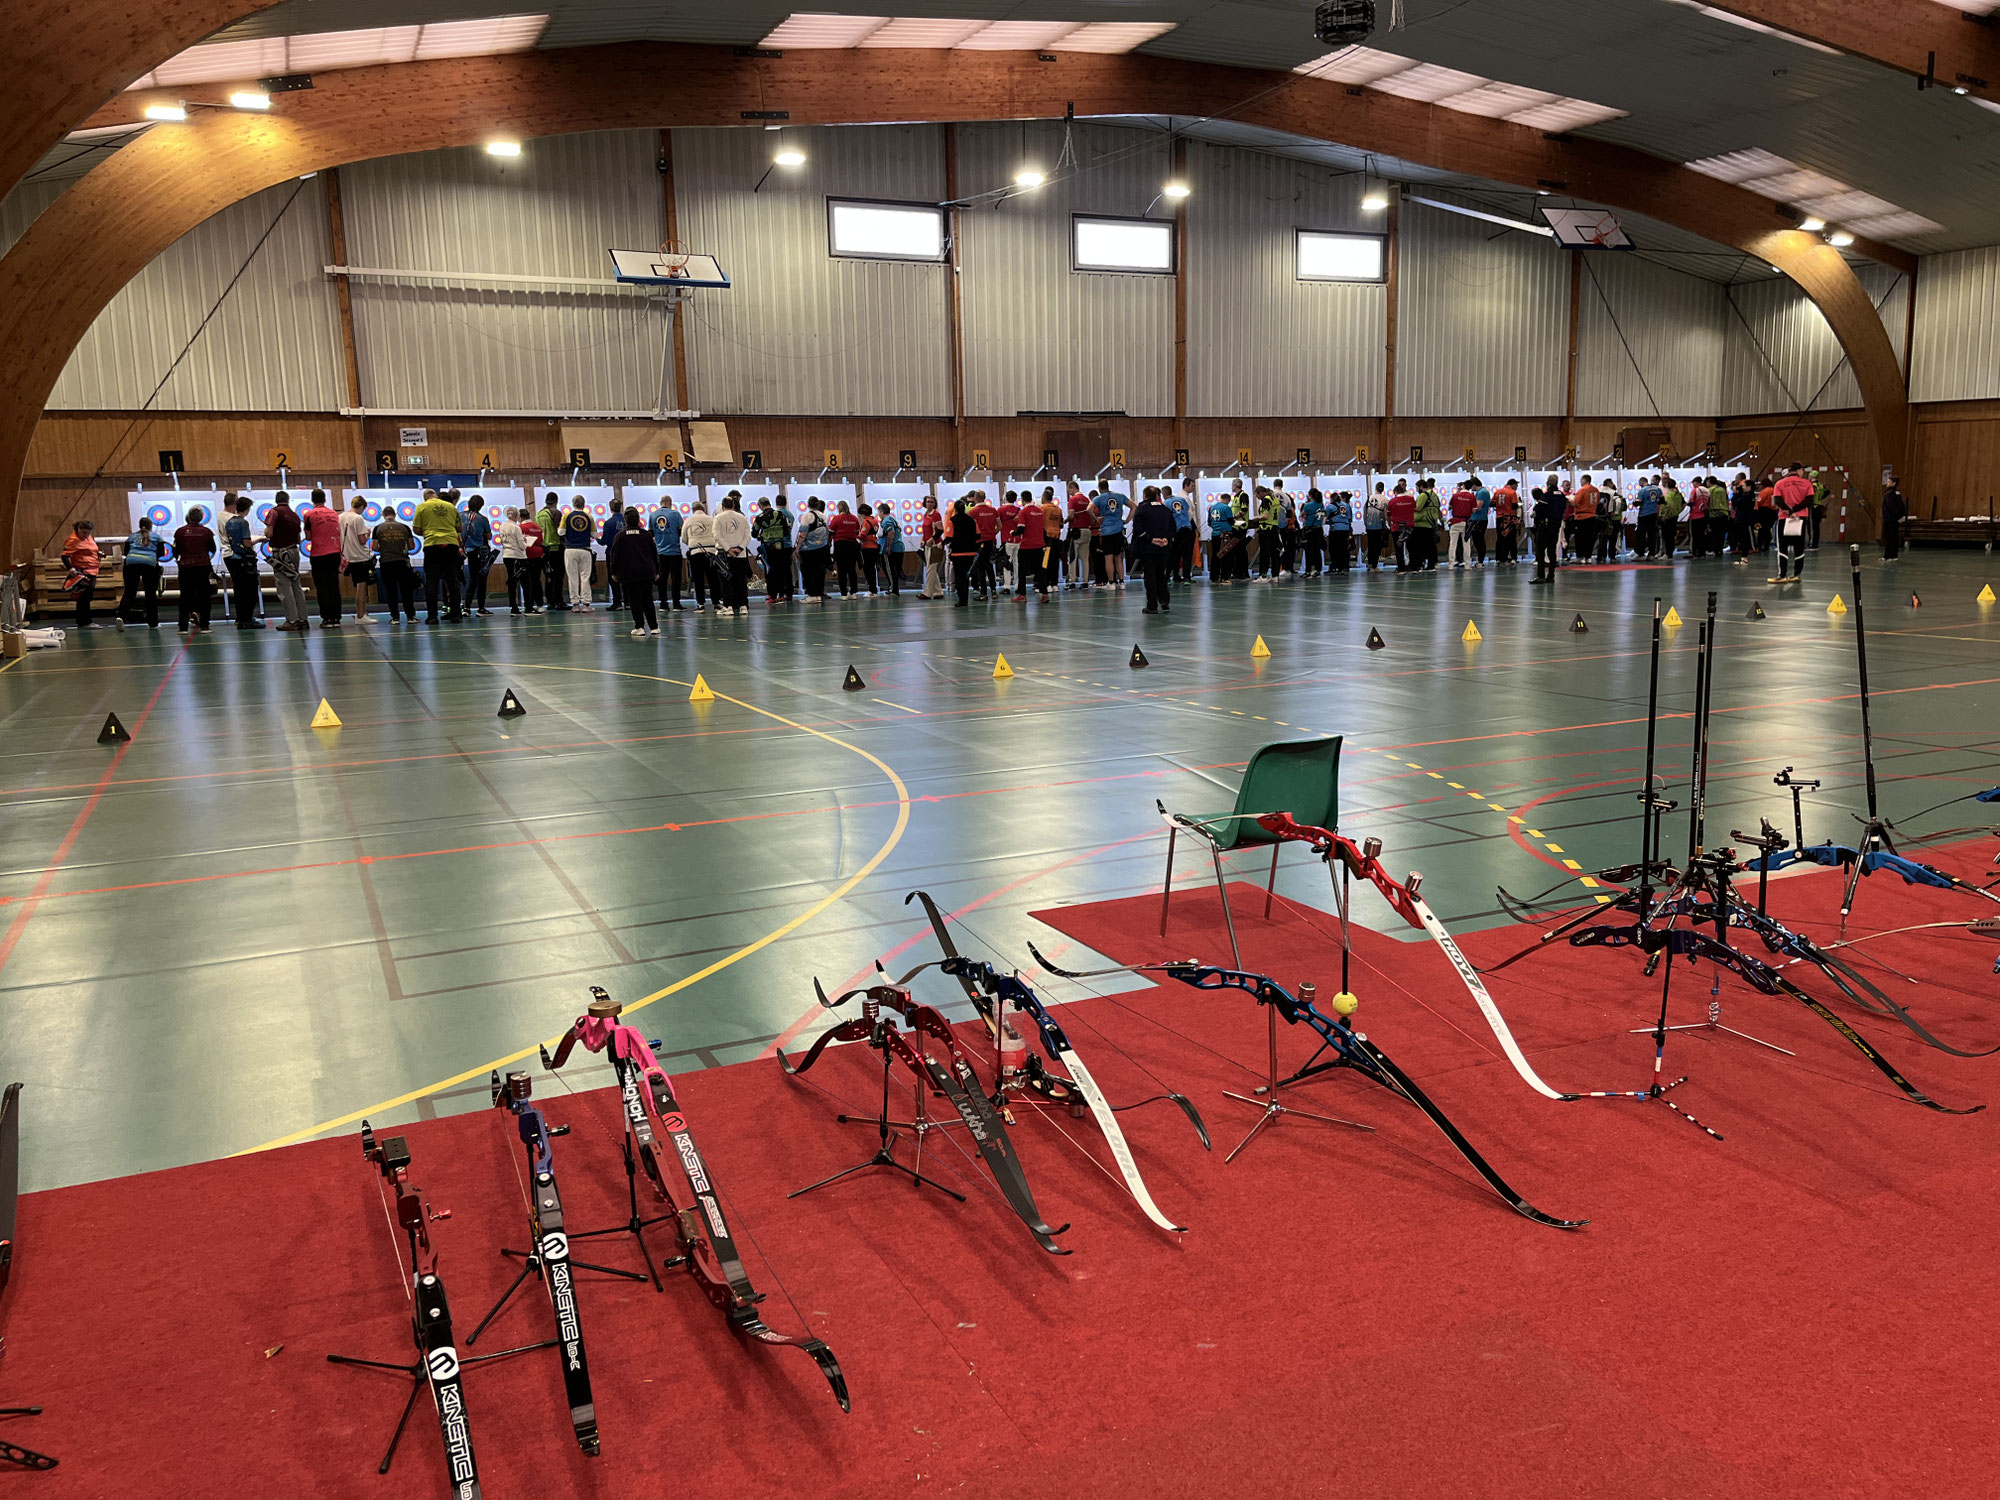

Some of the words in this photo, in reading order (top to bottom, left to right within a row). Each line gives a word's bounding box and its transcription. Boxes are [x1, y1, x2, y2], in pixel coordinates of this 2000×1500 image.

[1357, 449, 1367, 461] 16
[1412, 448, 1421, 460] 17
[1466, 448, 1474, 460] 18
[1516, 449, 1525, 460] 19
[1566, 448, 1576, 459] 20
[1614, 447, 1623, 458] 21
[1659, 447, 1669, 458] 22
[1706, 445, 1717, 456] 23
[1750, 444, 1759, 455] 24
[168, 455, 174, 470] 1
[277, 453, 288, 467] 2
[382, 455, 393, 469] 3
[482, 453, 491, 467] 4
[575, 453, 585, 466] 5
[664, 454, 674, 467] 6
[747, 454, 757, 467] 7
[829, 453, 838, 466] 8
[903, 454, 913, 466] 9
[975, 453, 987, 467] 10
[1048, 453, 1056, 466] 11
[1113, 453, 1122, 466] 12
[1177, 452, 1187, 464] 13
[1240, 452, 1250, 464] 14
[1298, 451, 1308, 463] 15
[110, 725, 116, 735] 1
[1443, 937, 1484, 990] HOYT
[674, 1133, 710, 1194] KINETIC
[552, 1262, 579, 1342] KINETIC
[440, 1383, 473, 1480] KINETIC
